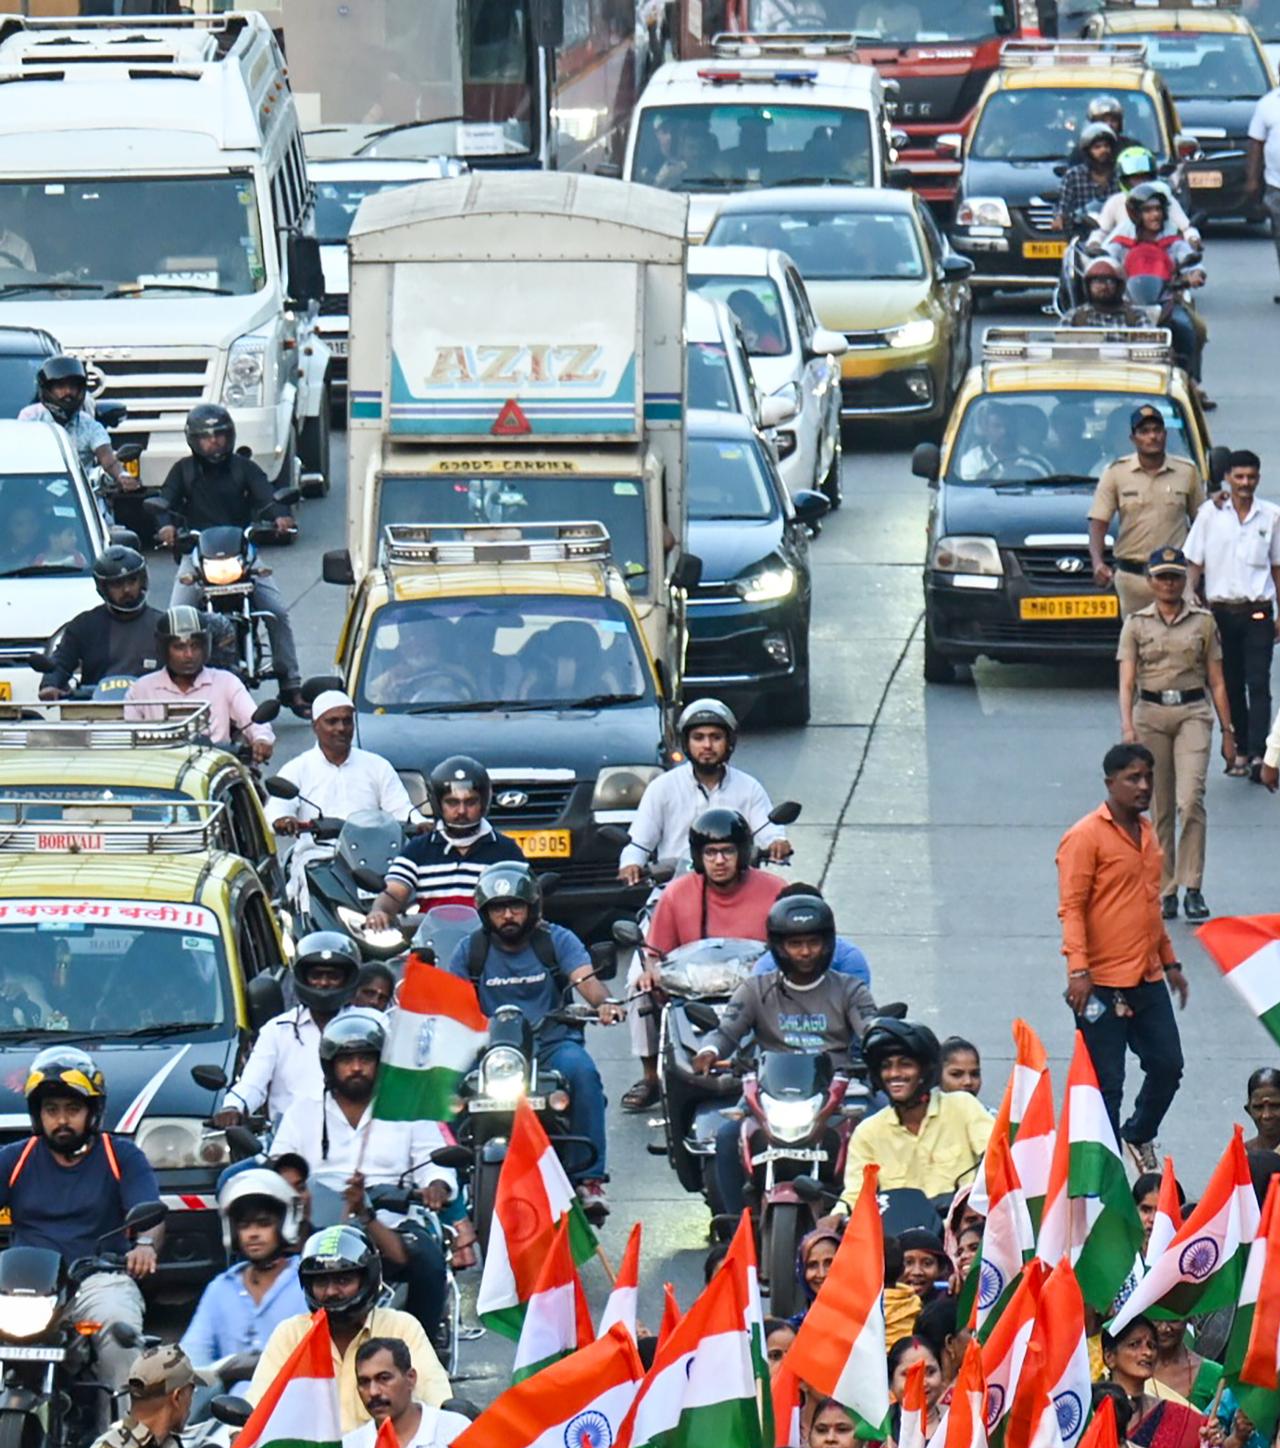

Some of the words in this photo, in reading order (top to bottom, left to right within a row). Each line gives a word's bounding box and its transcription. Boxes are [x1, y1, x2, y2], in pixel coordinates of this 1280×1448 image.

[424, 344, 605, 386] AZIZ
[438, 460, 494, 471] GOODS
[503, 460, 574, 471] CARRIER
[38, 834, 102, 850] BORIVALI
[519, 835, 567, 851] T0905
[16, 902, 111, 918] बजरंग
